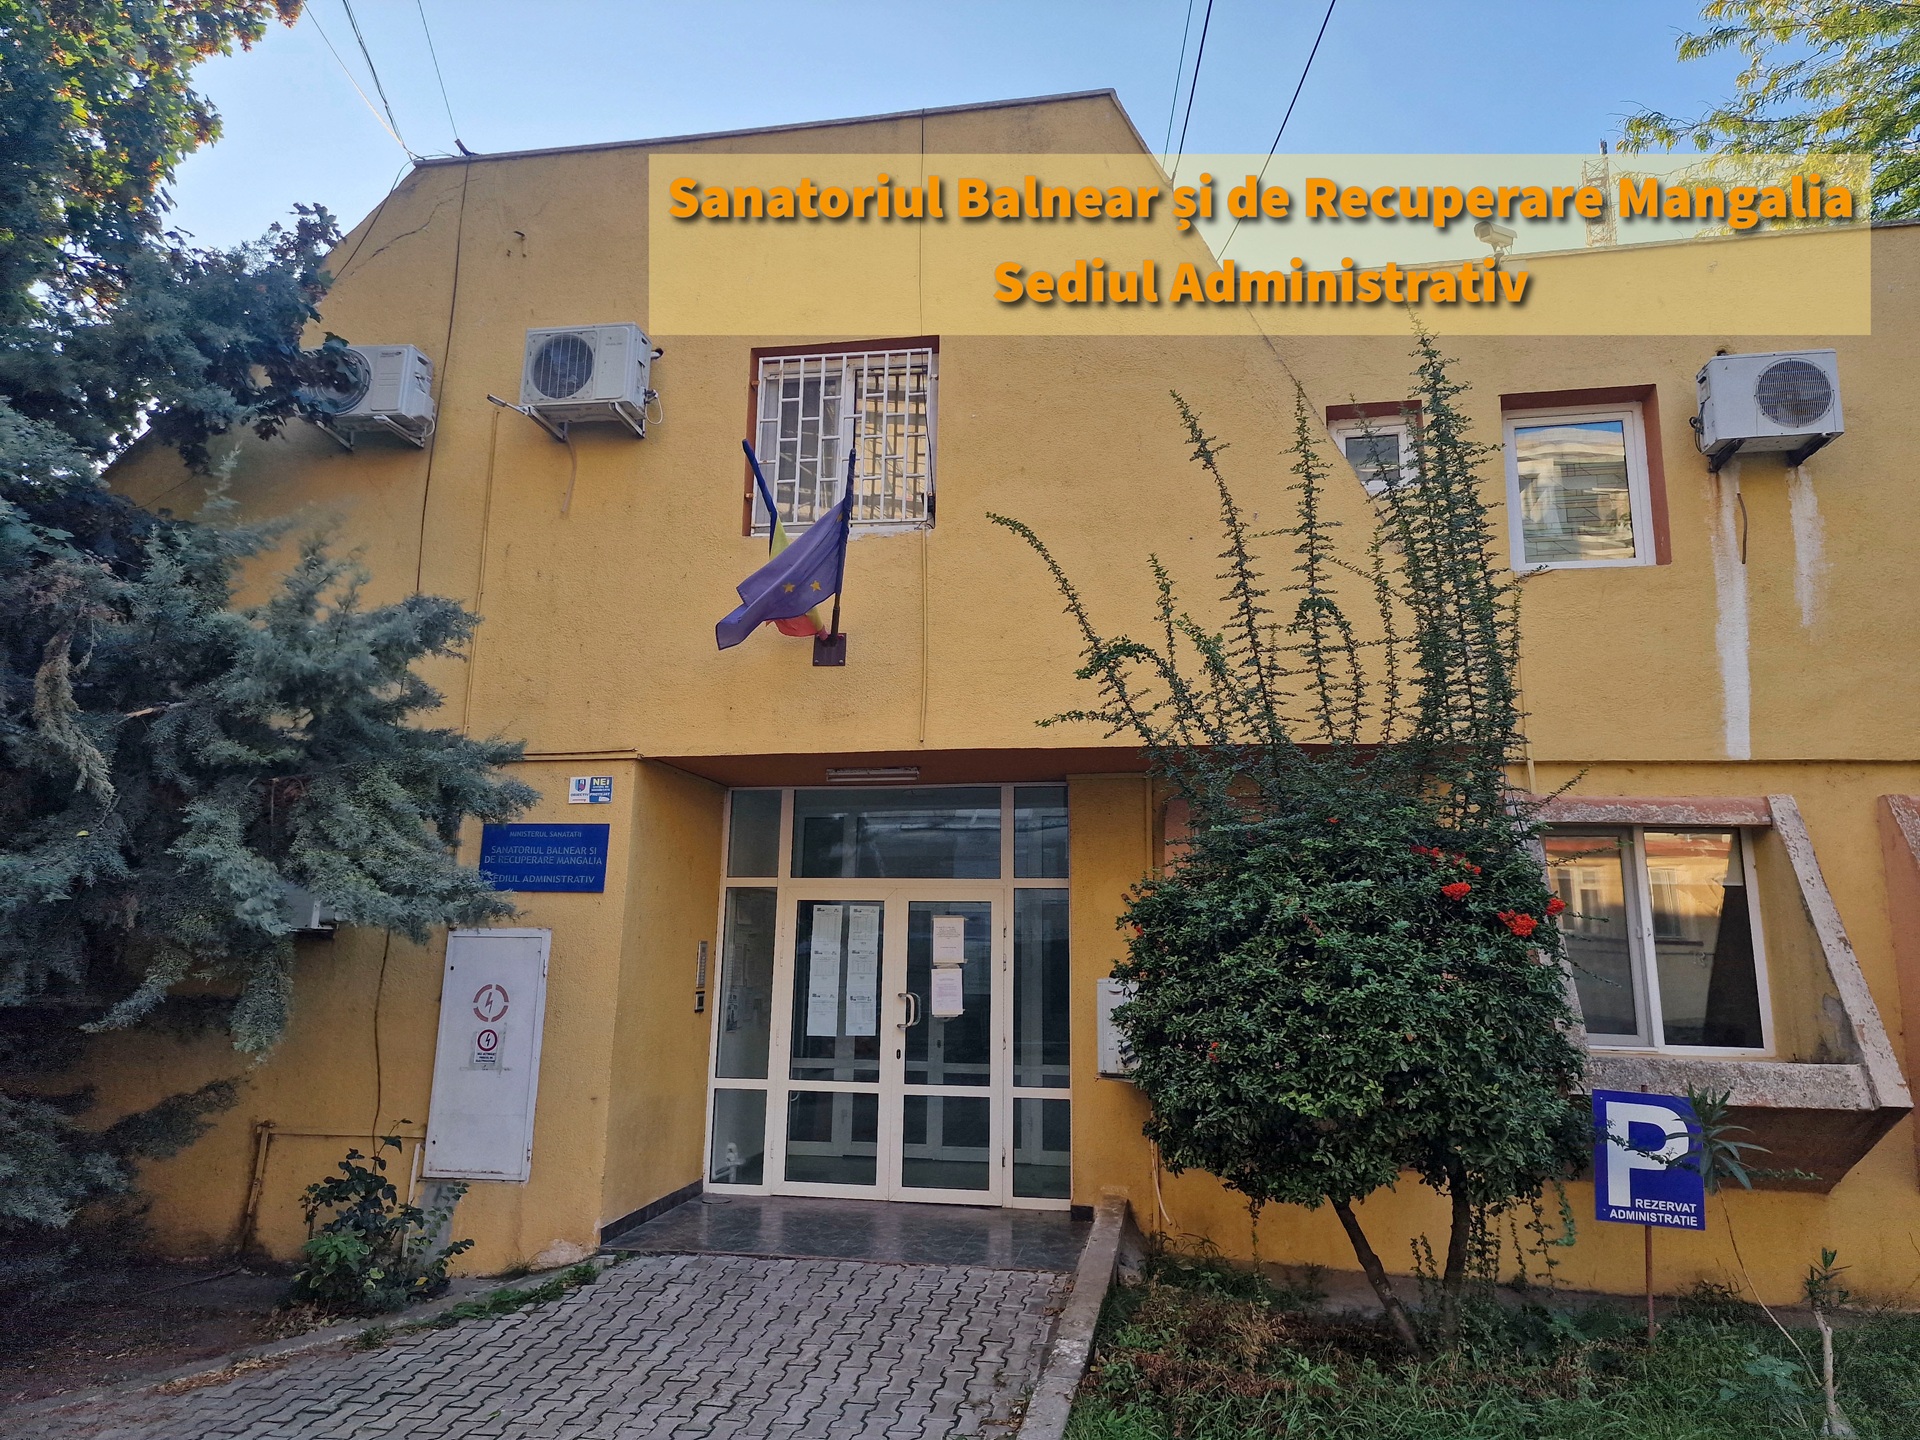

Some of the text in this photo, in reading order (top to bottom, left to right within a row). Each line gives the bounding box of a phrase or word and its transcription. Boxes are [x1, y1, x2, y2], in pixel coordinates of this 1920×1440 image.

[491, 845, 597, 855] SANATORIUL BALNEAR SI
[484, 855, 602, 865] DE RECUPERARE MANGALIA
[489, 874, 595, 884] SEDIUL ADMINISTRATIV
[1605, 1100, 1689, 1208] P
[1635, 1198, 1697, 1214] REZERVAT
